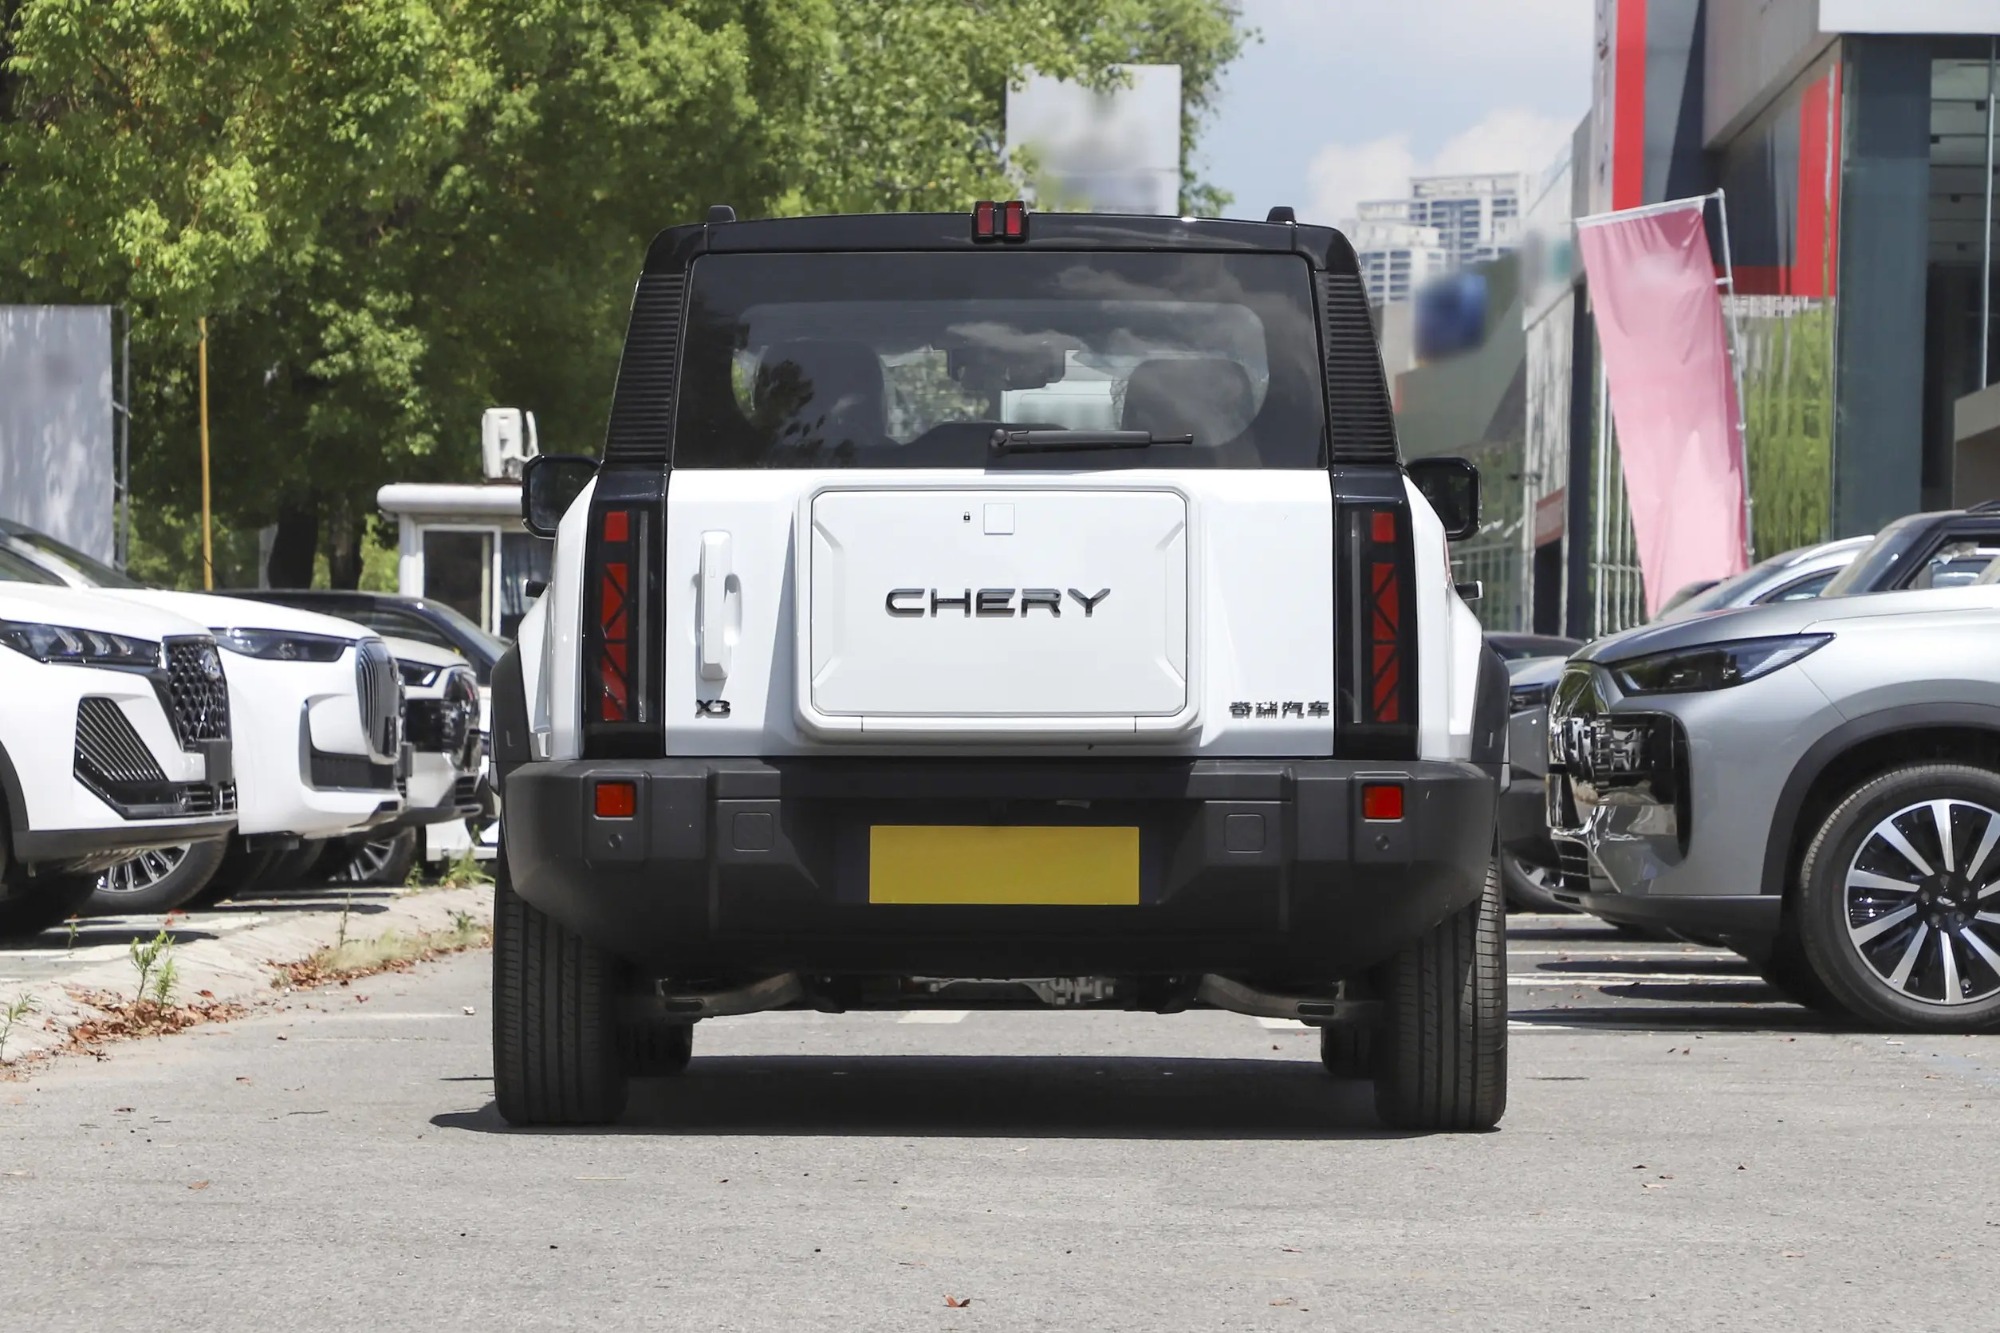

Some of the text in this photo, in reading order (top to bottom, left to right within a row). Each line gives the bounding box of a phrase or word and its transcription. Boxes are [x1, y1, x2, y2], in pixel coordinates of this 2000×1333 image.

[885, 588, 1111, 618] CHERY
[695, 699, 731, 719] X3
[1229, 700, 1330, 719] 奇瑞汽车
